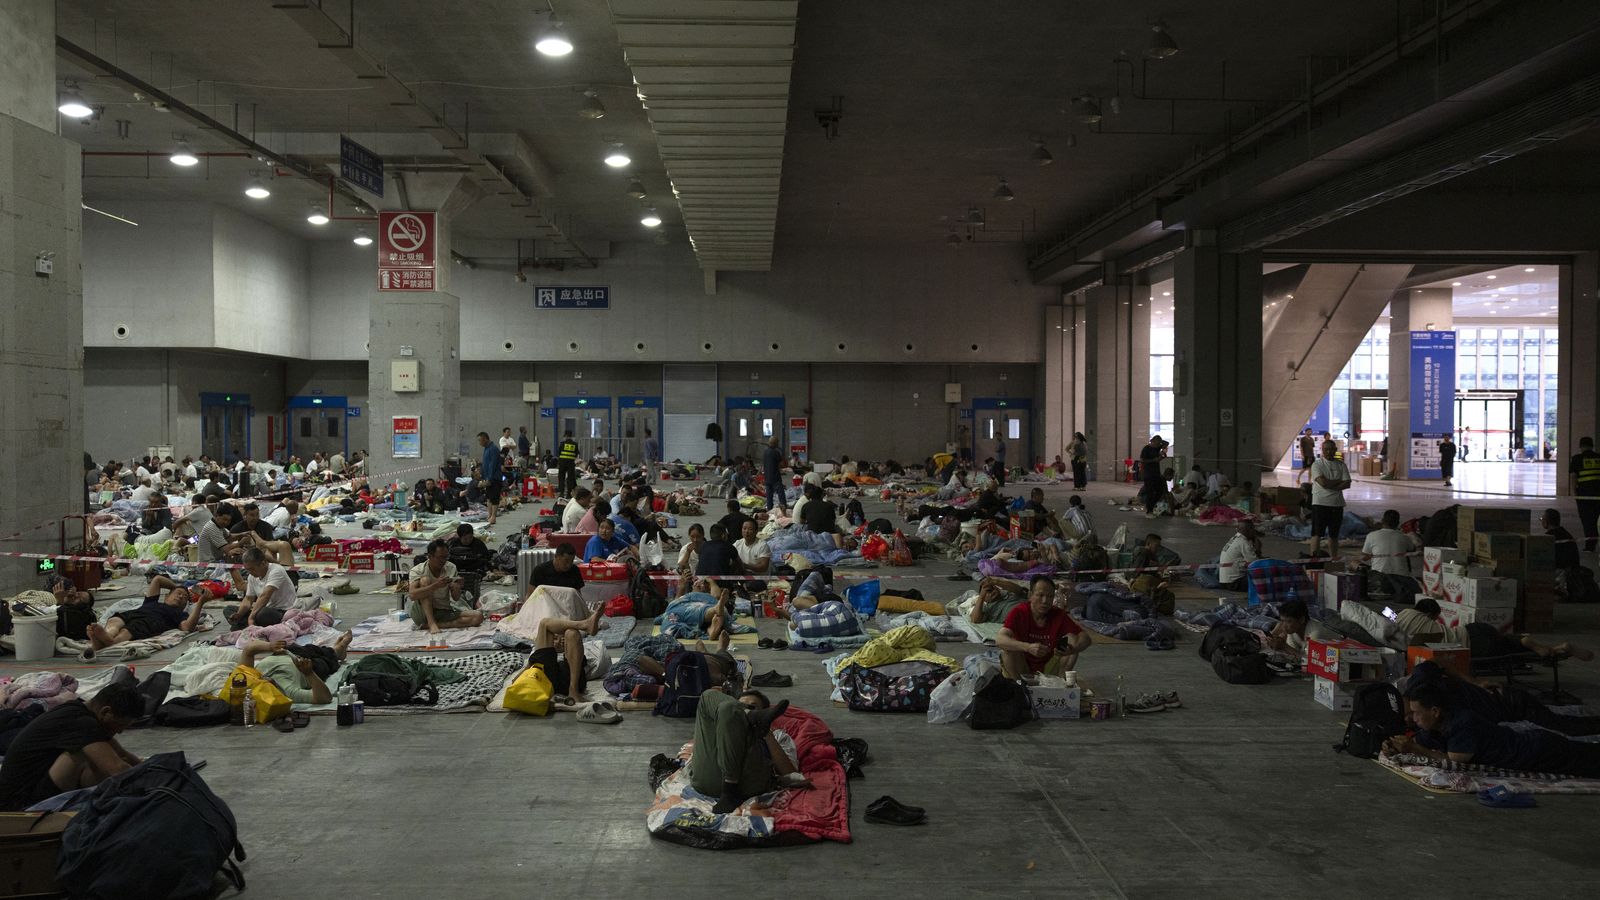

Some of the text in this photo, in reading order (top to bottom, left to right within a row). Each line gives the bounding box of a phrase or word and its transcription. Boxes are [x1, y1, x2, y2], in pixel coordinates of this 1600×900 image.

[389, 252, 424, 261] 禁止吸烟
[402, 271, 432, 279] 消防设施
[402, 279, 432, 288] 严禁遮挡
[560, 289, 604, 300] 应急出口
